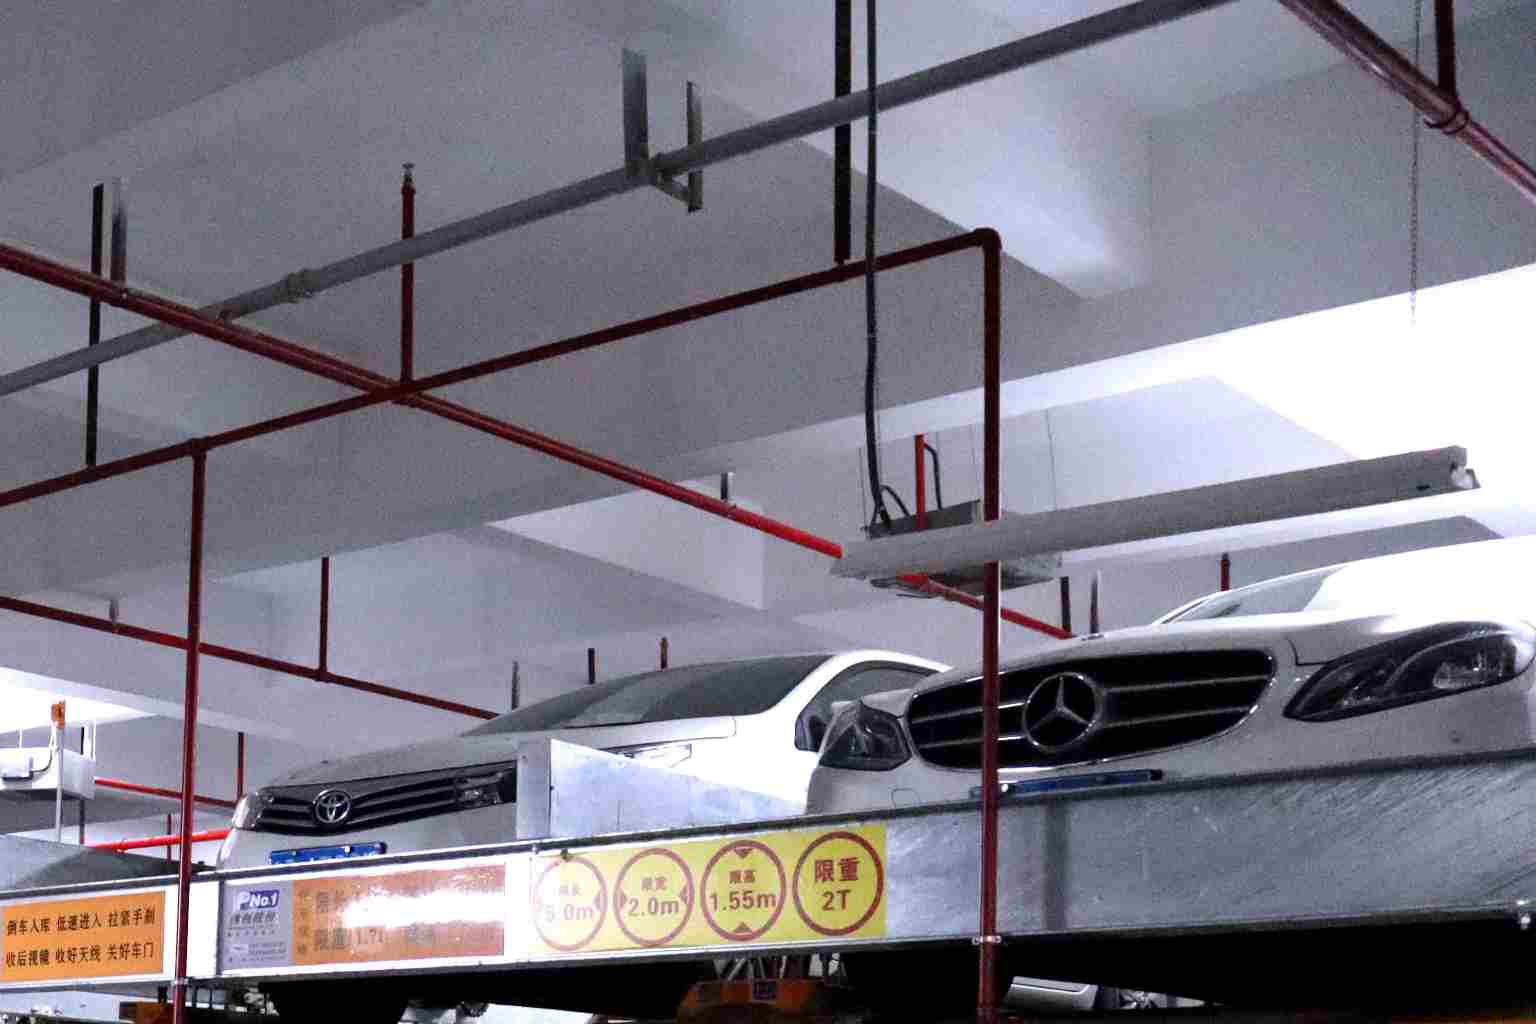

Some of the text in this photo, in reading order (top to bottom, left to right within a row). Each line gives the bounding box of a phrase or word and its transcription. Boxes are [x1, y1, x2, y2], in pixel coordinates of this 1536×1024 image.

[729, 869, 756, 885] 限高
[814, 858, 860, 884] 限重
[628, 900, 680, 918] 2.0m
[710, 890, 777, 913] 1.55m
[821, 888, 852, 912] 2T
[7, 918, 50, 936] 倒车入库
[56, 910, 102, 932] 低速进入
[6, 948, 49, 968] 收后视镜
[55, 944, 102, 964] 收好天线
[107, 941, 154, 961] 关好车门
